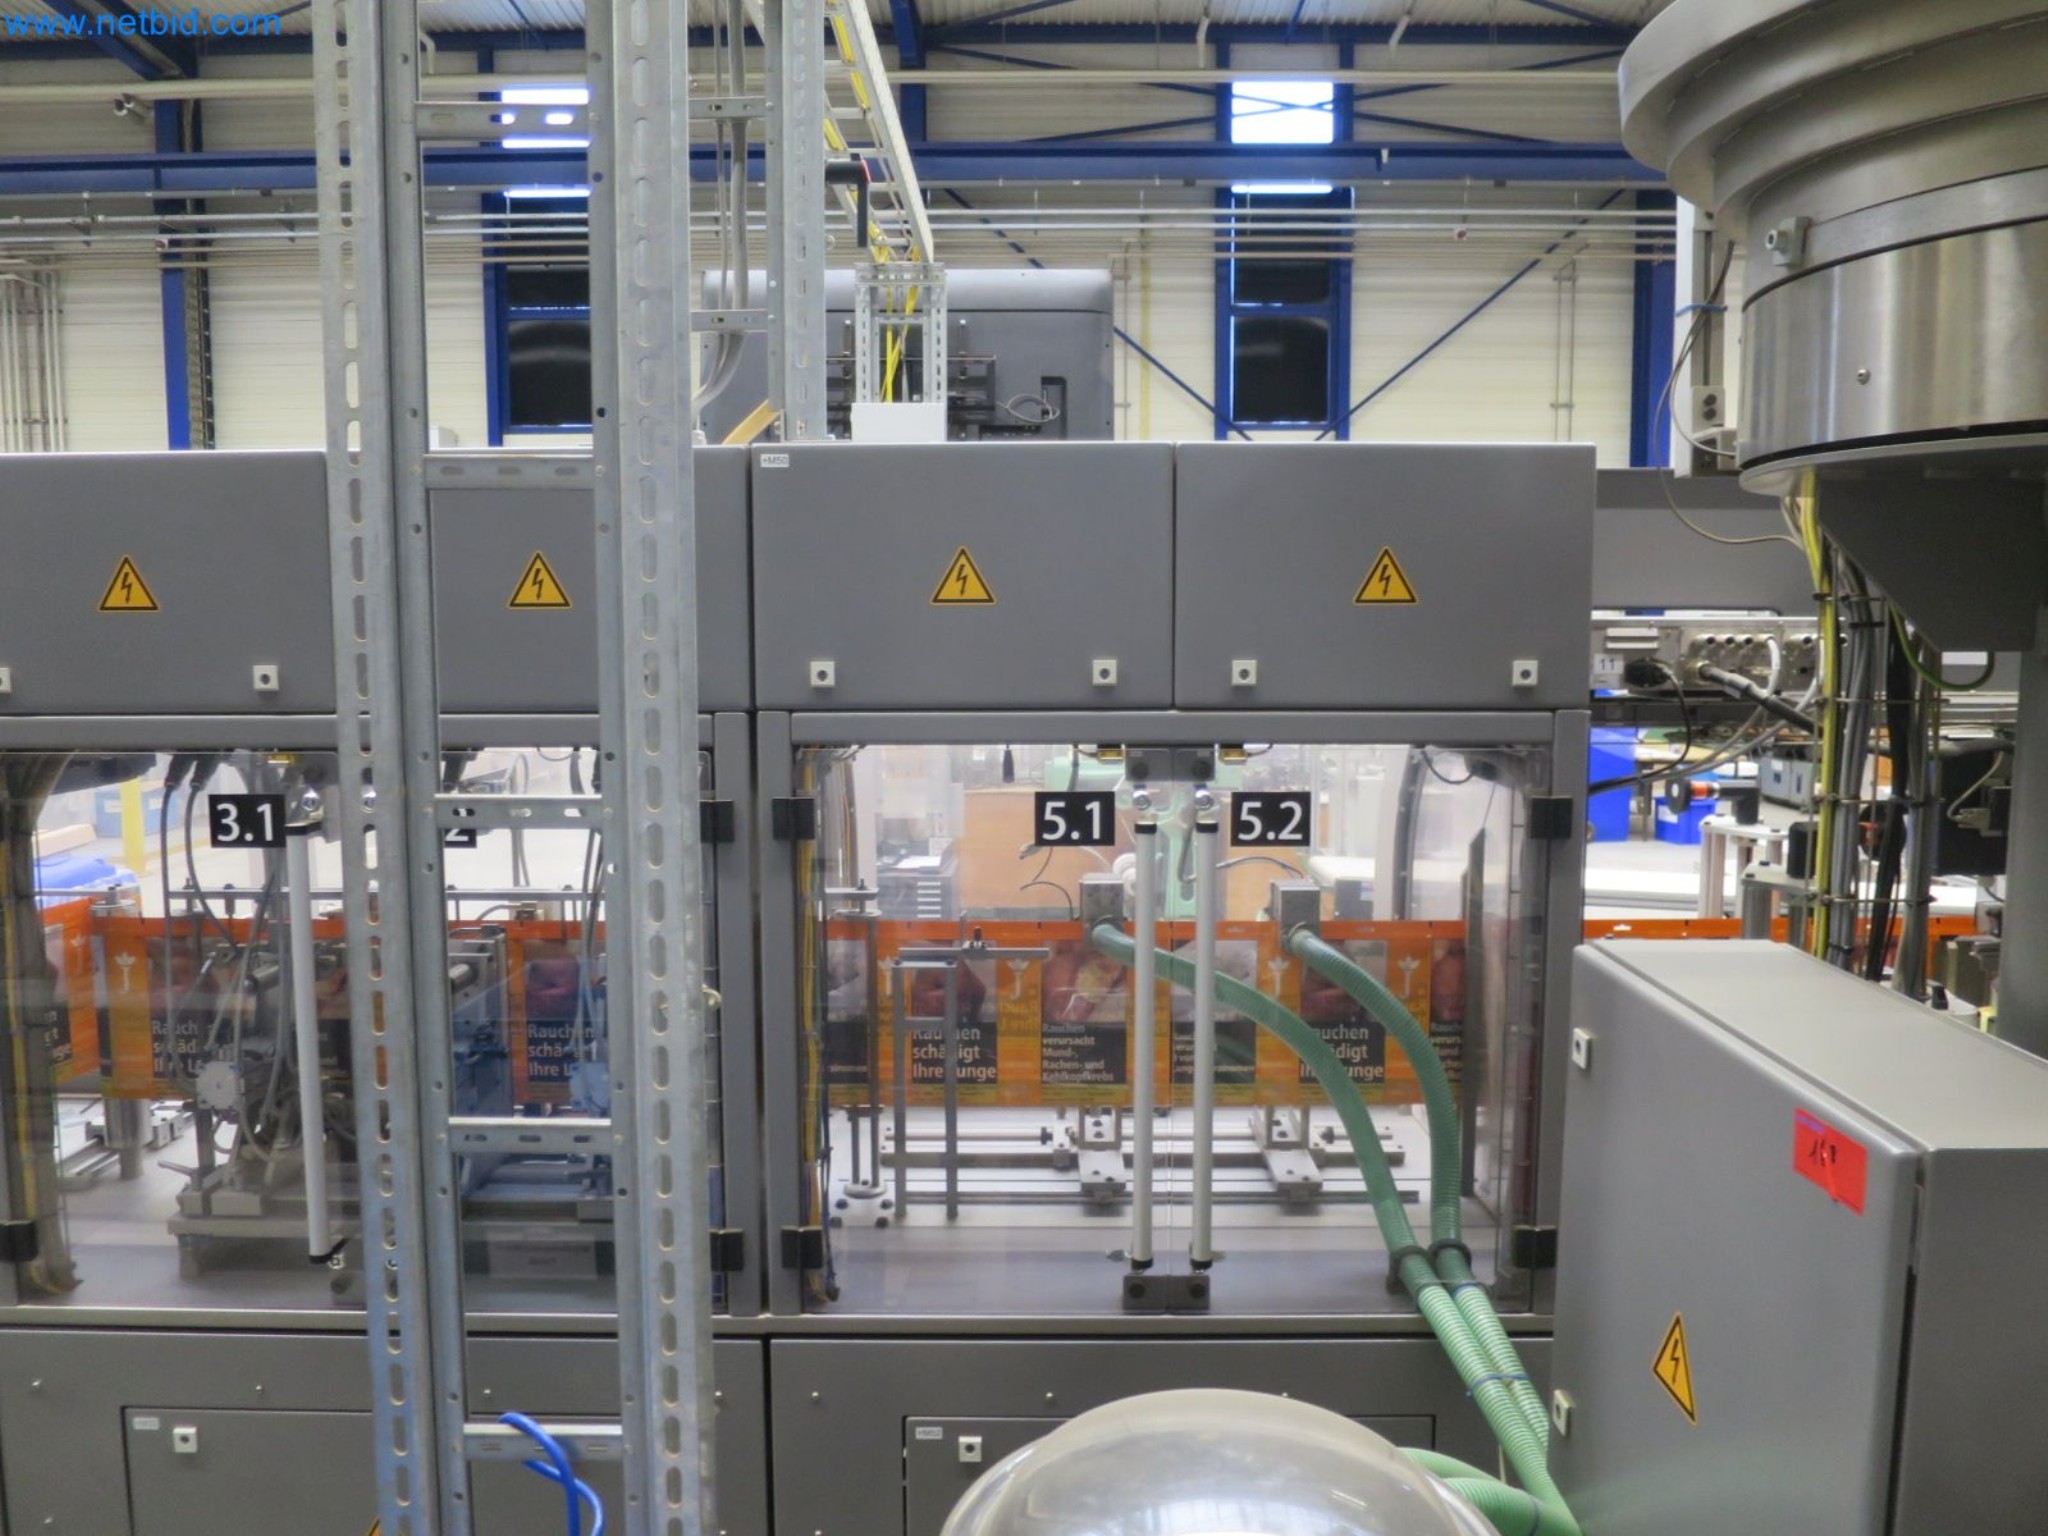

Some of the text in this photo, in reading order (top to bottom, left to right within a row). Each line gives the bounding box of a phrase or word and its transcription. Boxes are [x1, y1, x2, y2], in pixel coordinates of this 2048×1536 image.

[216, 802, 274, 842] 3.1
[1042, 801, 1101, 841] 5.1
[1238, 801, 1303, 841] 5.2
[1320, 1024, 1370, 1040] uchen
[913, 1044, 981, 1063] schäigt
[913, 1063, 997, 1082] Ihre unge
